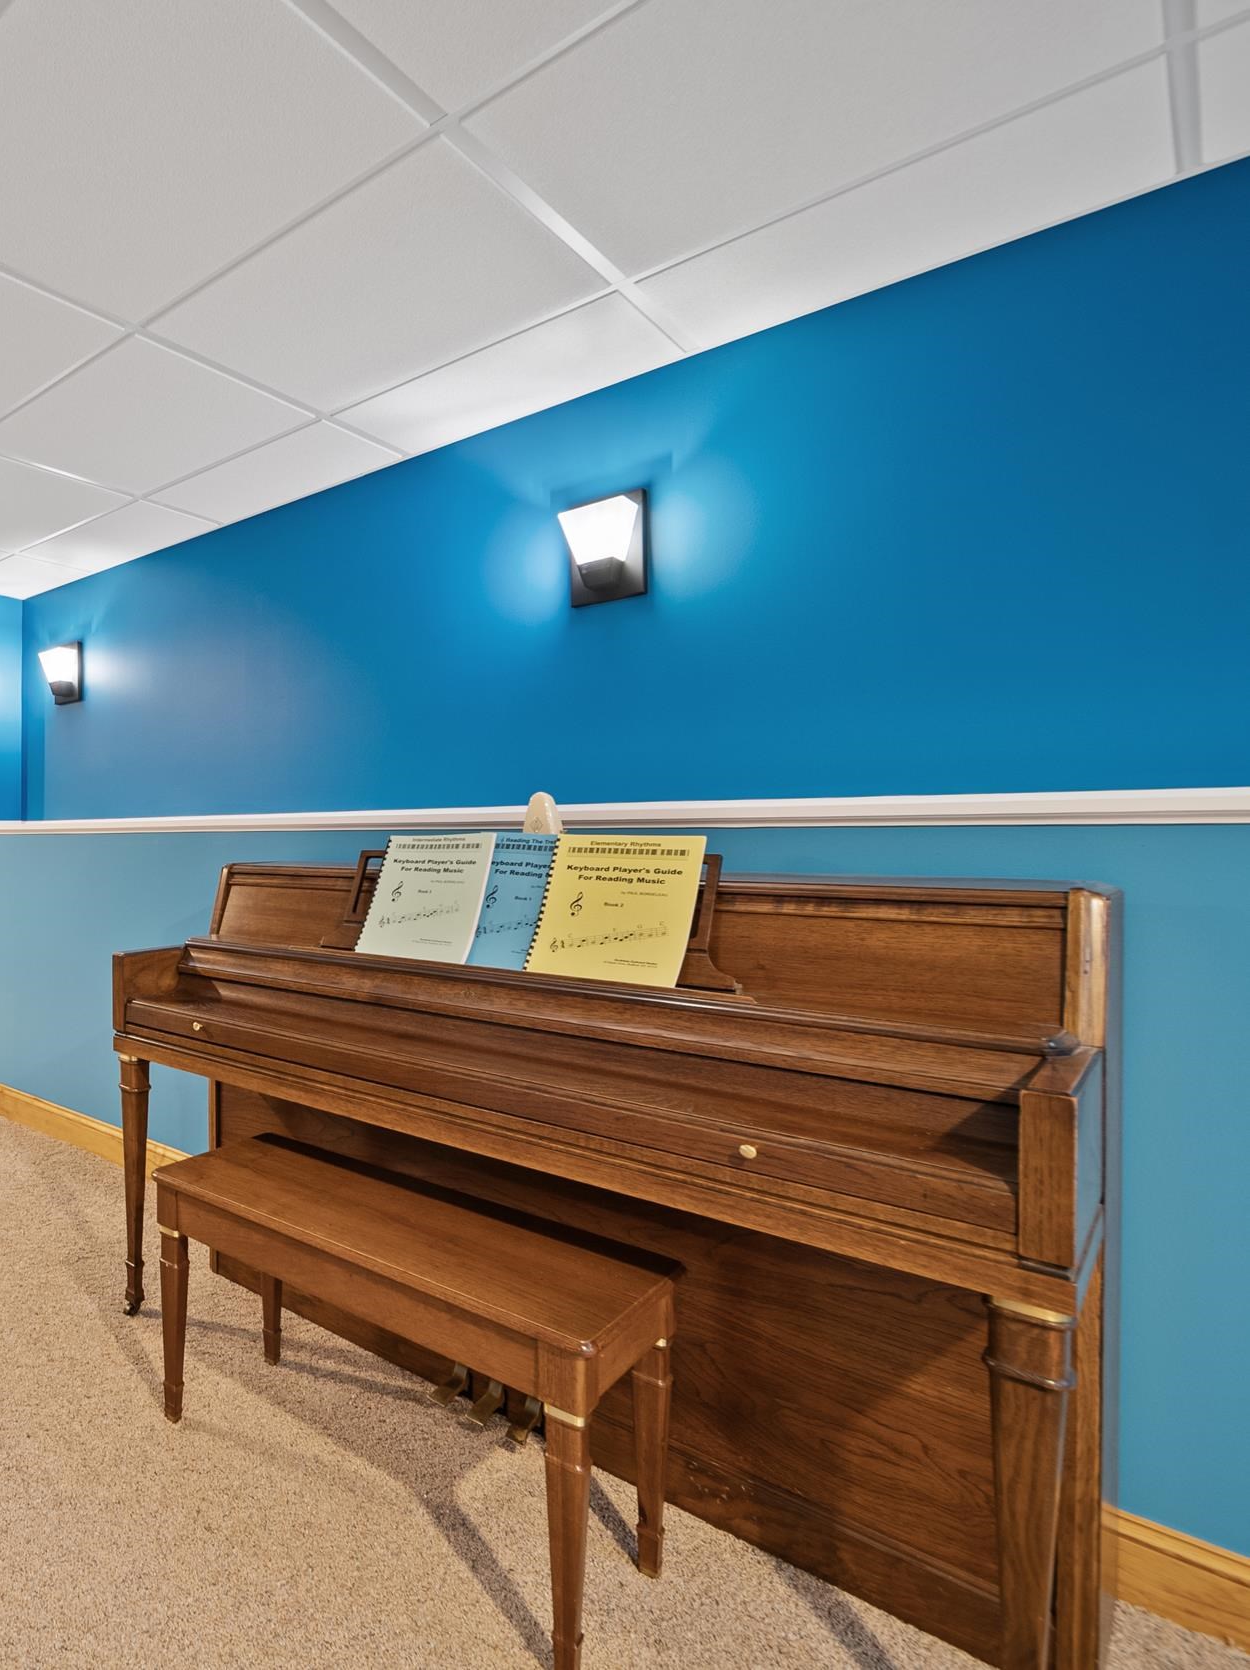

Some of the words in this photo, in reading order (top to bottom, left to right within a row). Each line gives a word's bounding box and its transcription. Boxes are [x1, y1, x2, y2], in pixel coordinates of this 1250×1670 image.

[509, 869, 543, 879] Reading
[567, 864, 610, 873] Keyboard
[612, 866, 651, 875] Player's
[595, 875, 634, 884] Reading
[636, 877, 666, 885] Music
